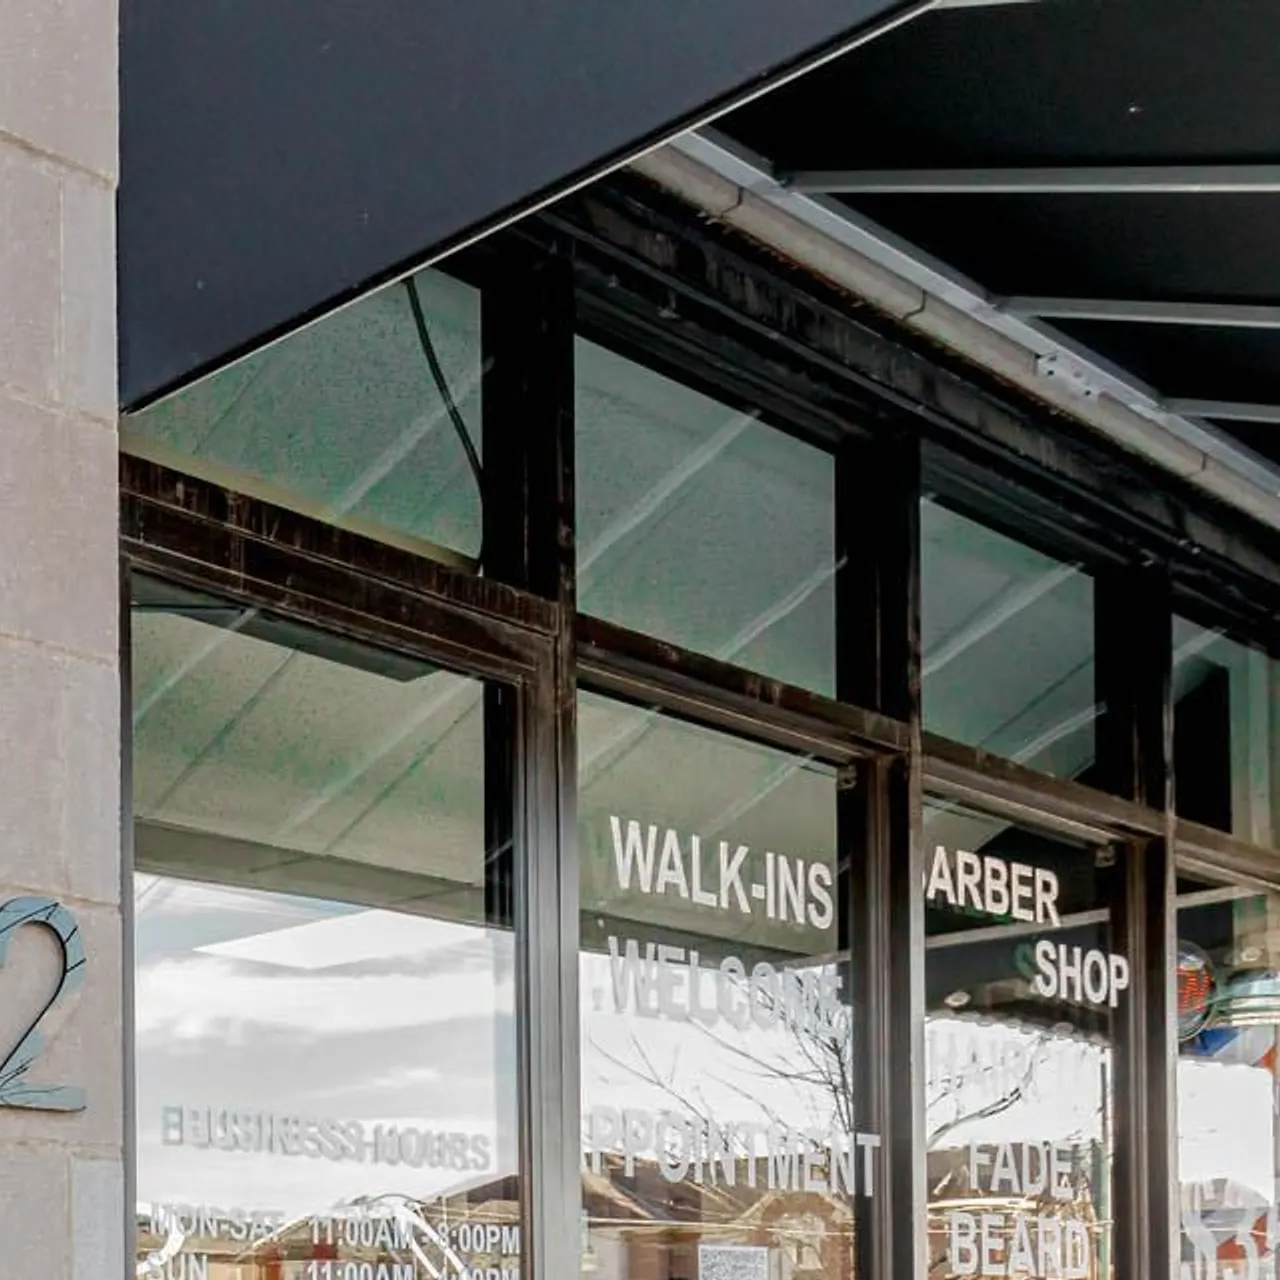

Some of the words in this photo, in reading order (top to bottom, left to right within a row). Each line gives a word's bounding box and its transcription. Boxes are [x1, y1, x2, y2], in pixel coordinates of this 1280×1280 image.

[609, 815, 834, 930] WALK-INS
[922, 846, 1062, 928] ARBER
[1034, 939, 1130, 1008] SHOP
[582, 1105, 881, 1197] PPOINTMENT
[969, 1139, 1074, 1200] FADE
[149, 1203, 286, 1242] MON-SAT
[307, 1216, 412, 1250] 11:00AM
